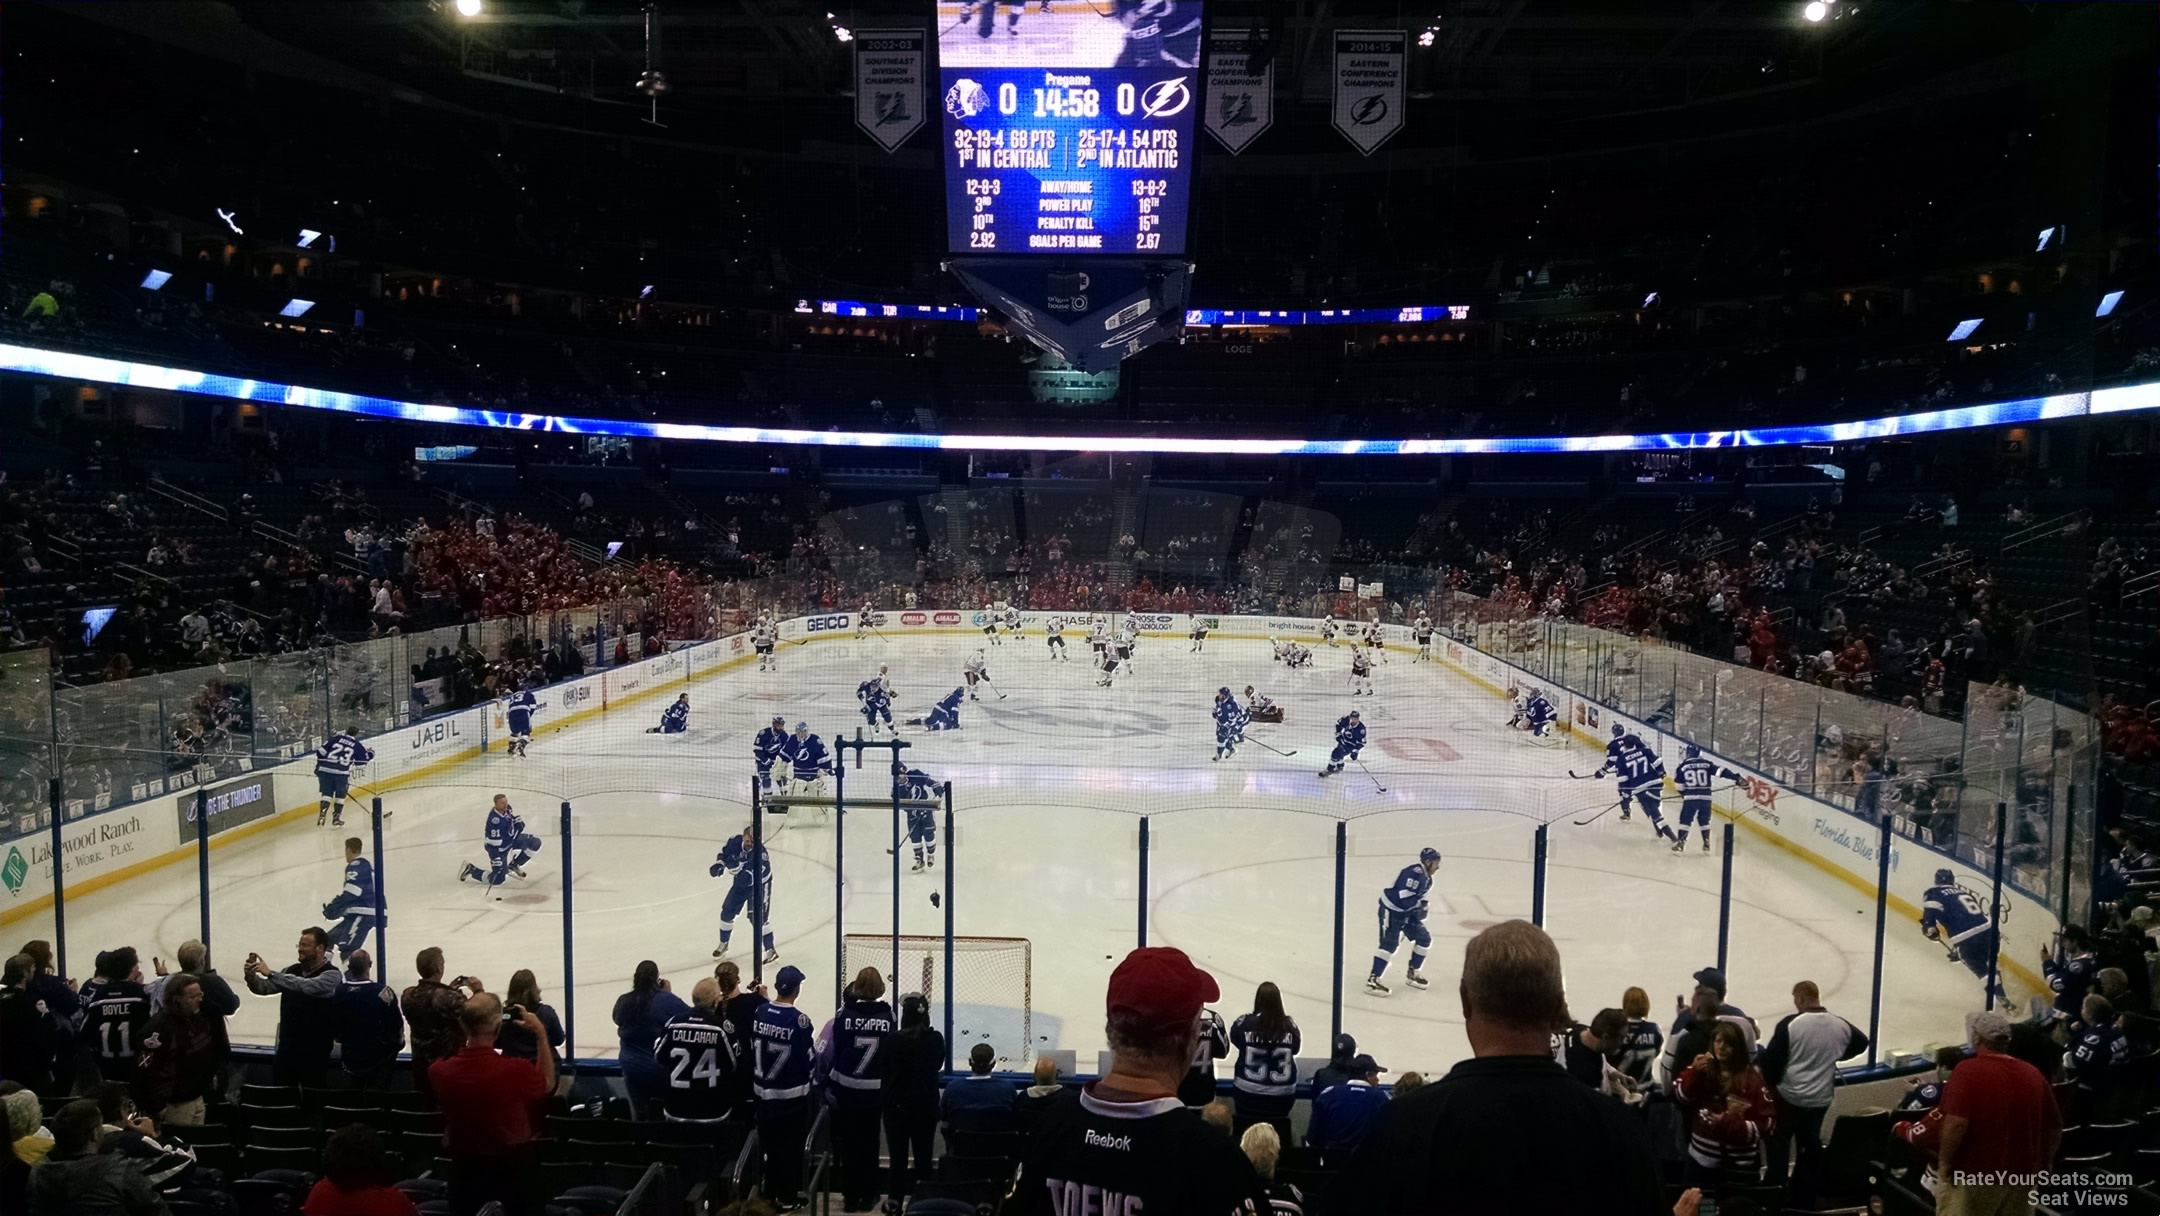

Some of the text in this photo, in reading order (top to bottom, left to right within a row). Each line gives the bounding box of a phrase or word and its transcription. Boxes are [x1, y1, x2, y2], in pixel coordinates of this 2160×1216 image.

[868, 41, 912, 49] 2002-03
[1350, 43, 1391, 51] 2014-15
[1350, 60, 1390, 68] EASTERN
[865, 77, 915, 85] CHAMPIONS
[1045, 73, 1090, 87] Pregame
[1340, 70, 1399, 78] CONFERENCE
[1344, 80, 1395, 88] CHAMPIONS
[999, 83, 1017, 114] 0
[1034, 89, 1100, 117] 14:58
[1117, 83, 1134, 114] 0
[955, 130, 1055, 148] 32-13-4 68 PTS
[1079, 130, 1177, 148] 25-17-4 54 PTS
[977, 150, 990, 168] IN
[994, 150, 1050, 168] CENTRAL
[1100, 150, 1114, 168] IN
[1117, 150, 1178, 168] ATLANTIC
[966, 180, 1000, 195] 12-8-3
[1041, 180, 1092, 193] AWAY/HOME
[1132, 180, 1166, 195] 13-8-2
[1040, 199, 1093, 211] POWER PLAY
[1038, 217, 1093, 229] PENALTY KILL
[971, 232, 995, 247] 2.92
[1030, 235, 1102, 247] GOALS PER GAME
[1136, 233, 1160, 249] 2.67
[883, 305, 897, 316] TOR
[1226, 345, 1253, 354] LOGE
[807, 616, 849, 632] GEICO
[1269, 621, 1316, 631] bright house
[579, 686, 591, 701] SUN
[412, 719, 460, 749] JABIL
[327, 742, 354, 766] 23
[1626, 756, 1649, 778] 77
[1684, 769, 1709, 787] 90
[208, 784, 262, 816] BE THE THUNDER
[100, 816, 140, 842] Ranch
[1814, 818, 1850, 849] Florida
[1852, 836, 1874, 861] Blue
[1406, 877, 1419, 889] 89
[1958, 894, 1981, 914] 6
[102, 1003, 131, 1016] BOYLE
[99, 1021, 135, 1058] 11
[672, 1029, 718, 1045] CALLAHAN
[753, 1037, 792, 1080] 17
[853, 1036, 880, 1075] 7
[669, 1047, 720, 1089] 24
[1244, 1046, 1292, 1083] 53
[1085, 1129, 1131, 1152] Reebok
